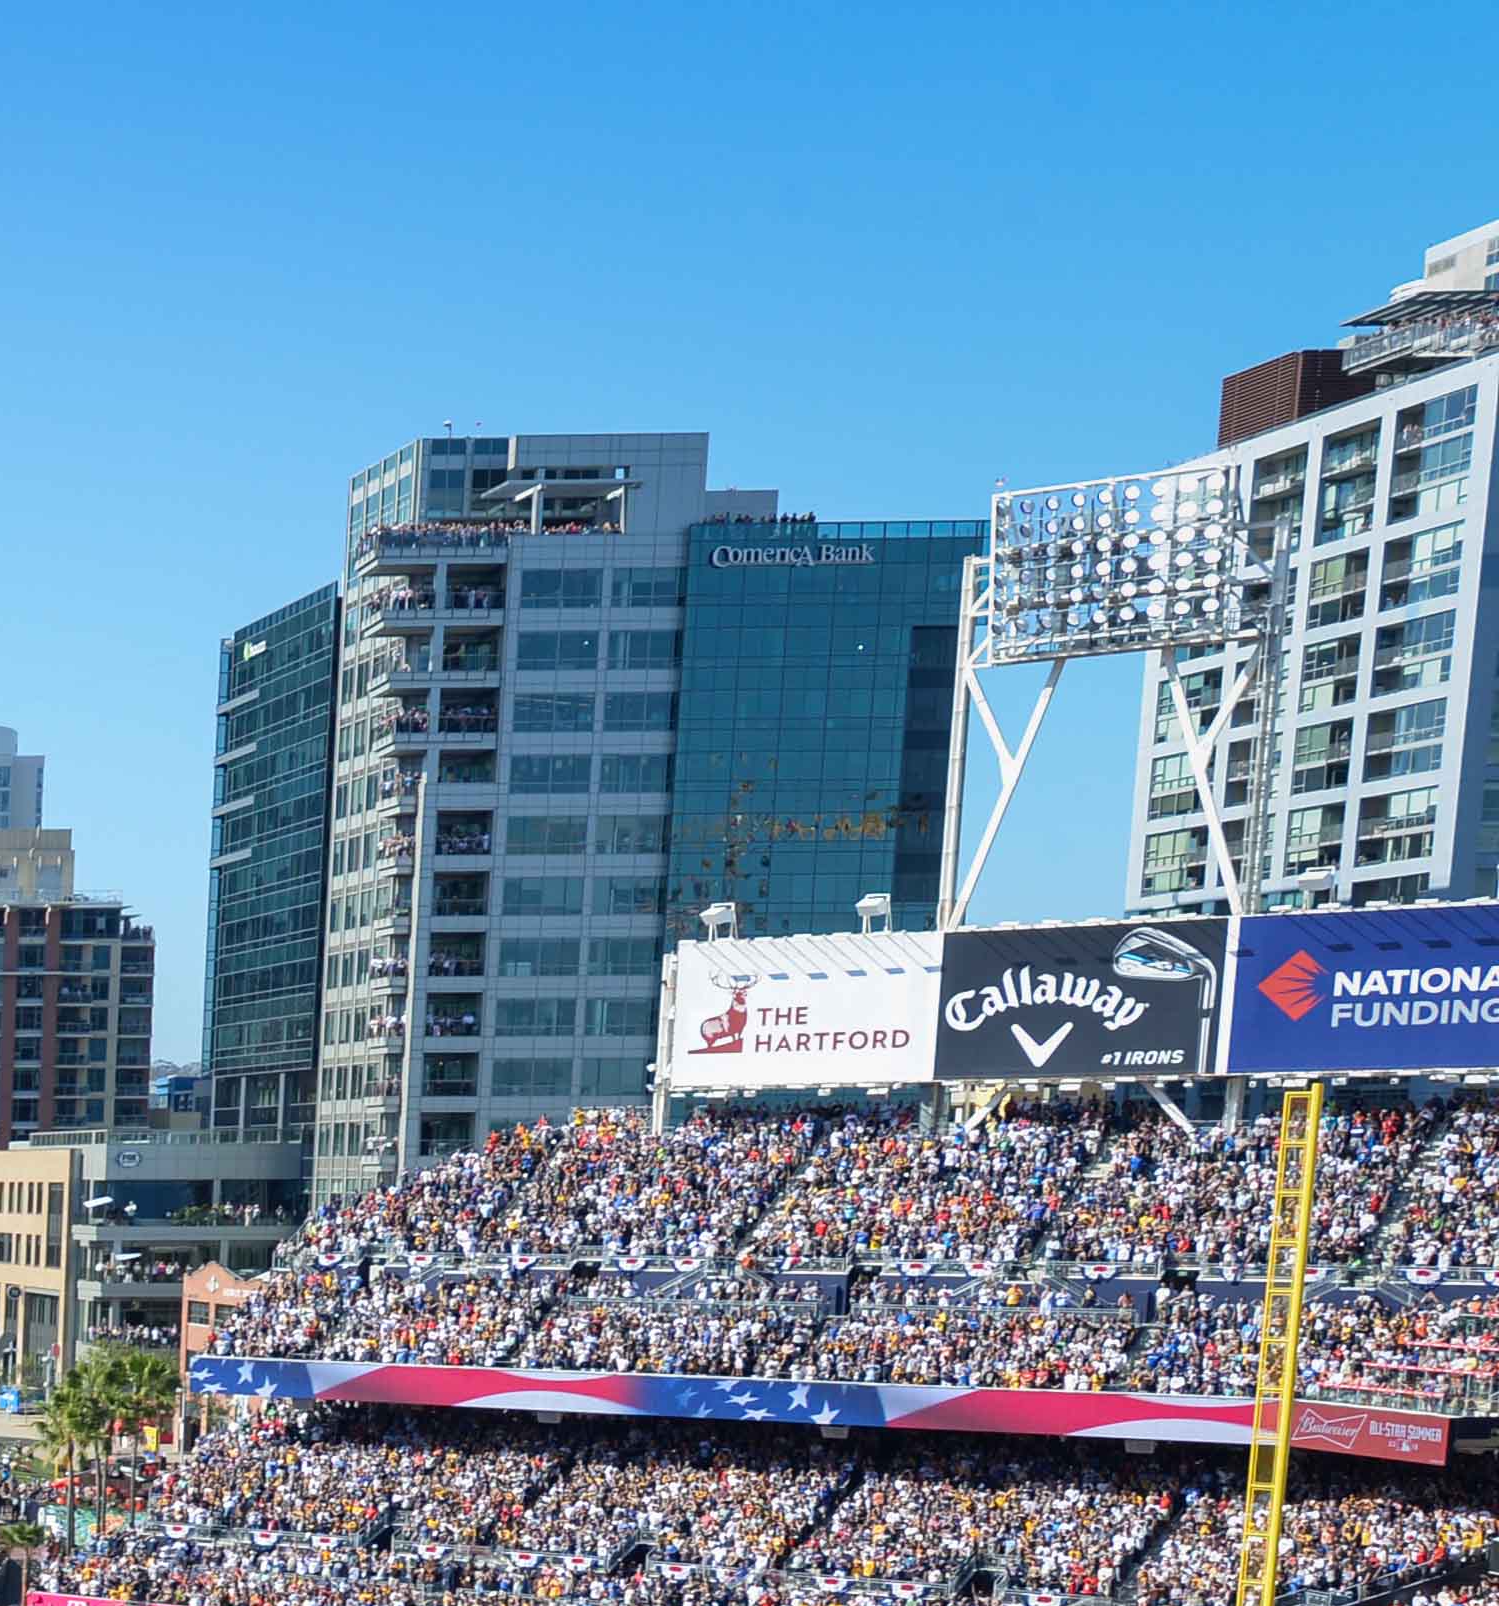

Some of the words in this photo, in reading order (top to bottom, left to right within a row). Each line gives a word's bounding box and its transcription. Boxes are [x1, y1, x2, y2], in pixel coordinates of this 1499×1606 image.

[819, 543, 876, 562] Bank
[945, 966, 1148, 1031] Callaway
[757, 1006, 809, 1026] THE
[754, 1029, 911, 1053] HARTFORD
[1100, 1050, 1122, 1065] #1
[1124, 1049, 1186, 1066] IRONS
[1300, 1415, 1359, 1438] Budweiser
